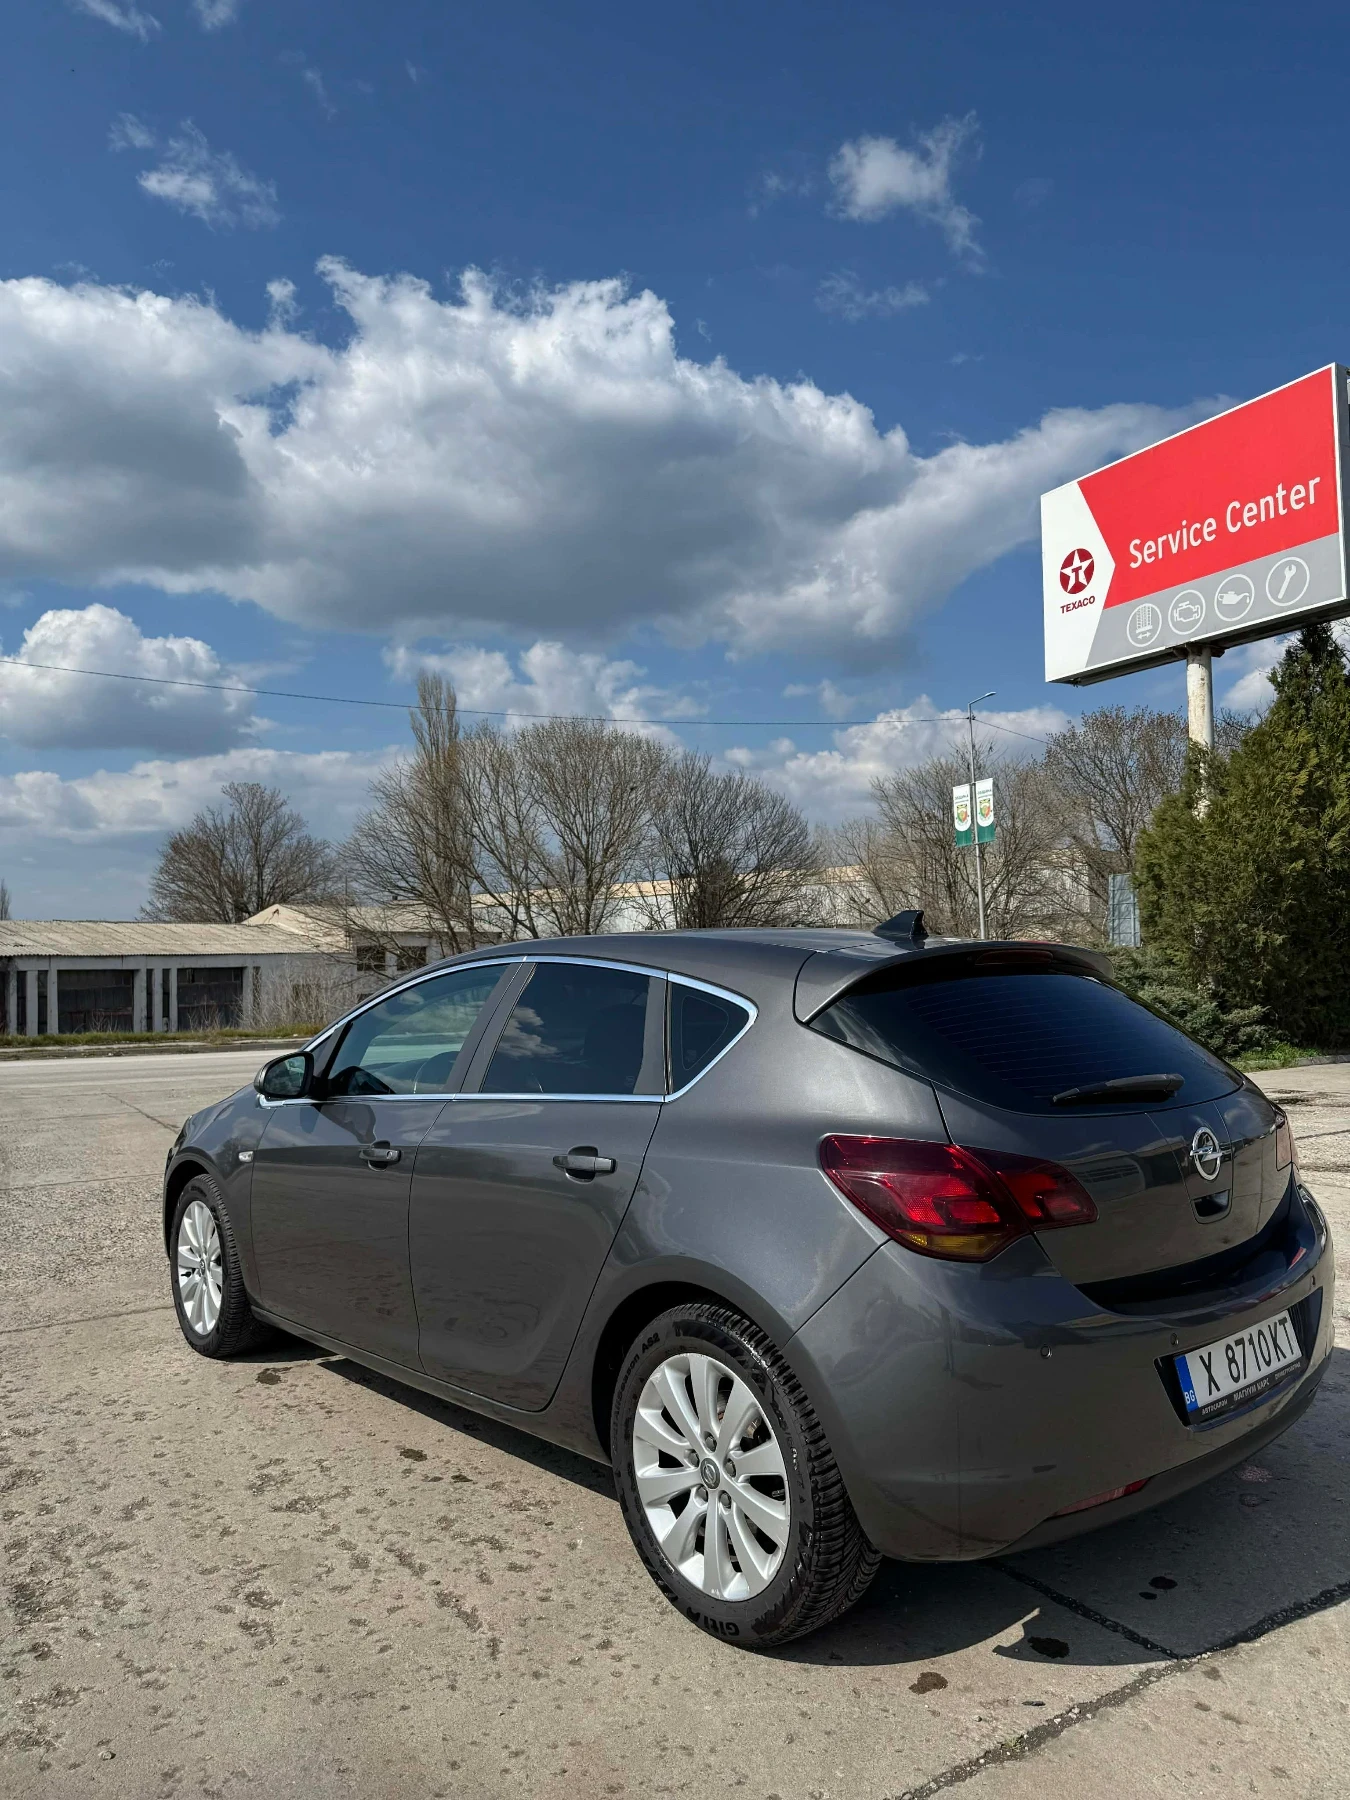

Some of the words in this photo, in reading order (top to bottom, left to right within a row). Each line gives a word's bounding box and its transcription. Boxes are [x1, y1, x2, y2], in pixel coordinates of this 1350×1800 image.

[1128, 519, 1217, 569] Service
[1225, 476, 1321, 533] Center
[1060, 595, 1096, 614] TEXACO
[641, 1332, 660, 1354] AS2
[1199, 1351, 1221, 1397] X
[1225, 1316, 1294, 1384] 8710KT
[1184, 1390, 1196, 1404] BG
